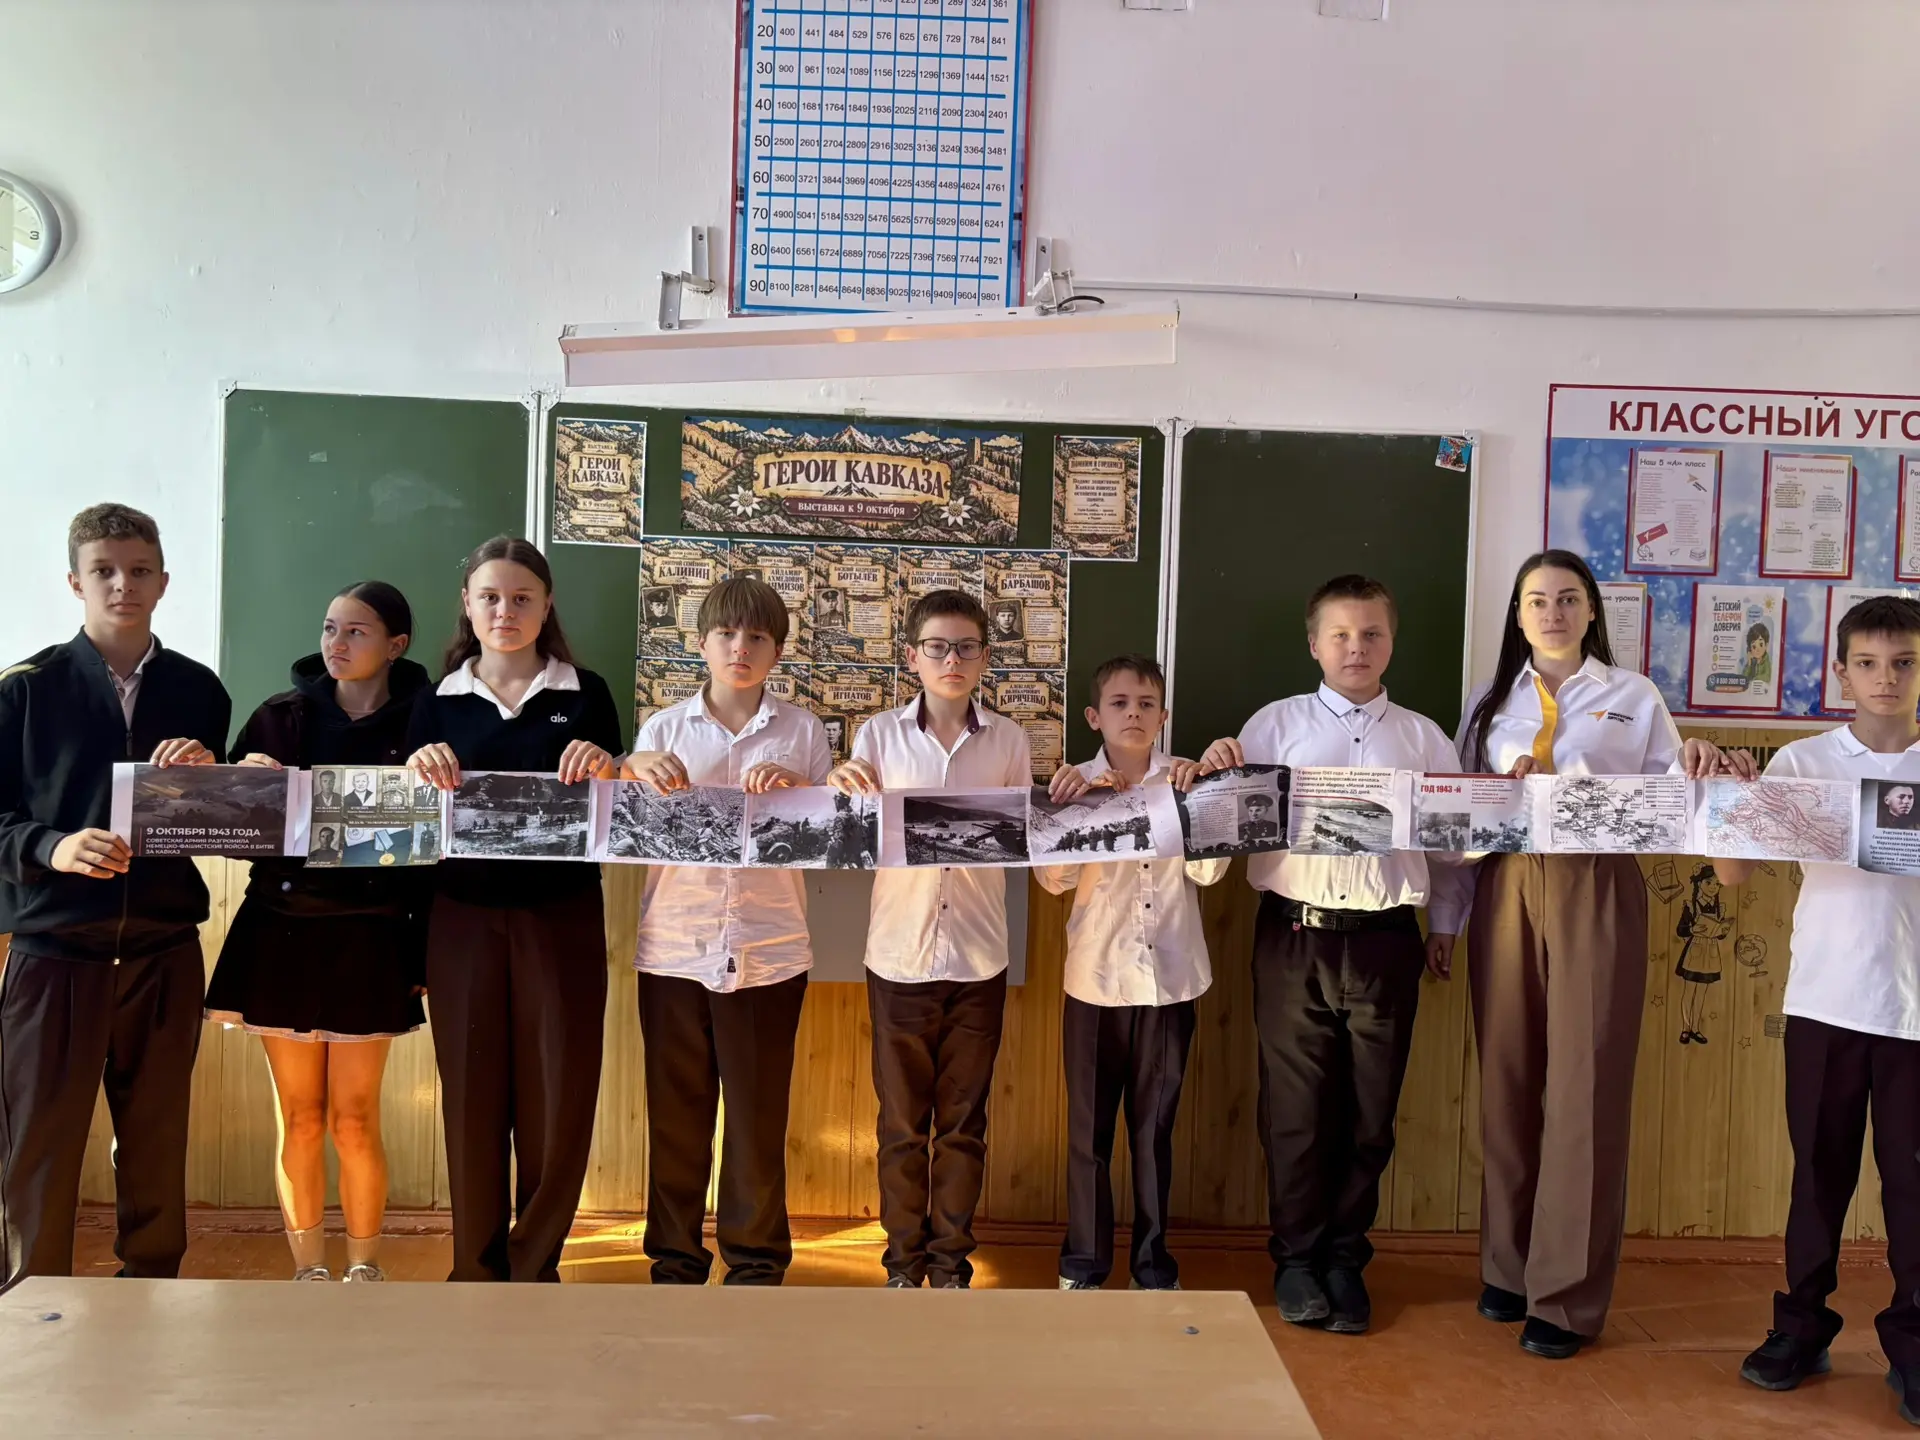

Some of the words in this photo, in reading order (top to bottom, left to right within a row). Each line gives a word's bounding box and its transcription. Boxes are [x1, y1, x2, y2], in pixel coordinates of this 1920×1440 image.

[993, 0, 1008, 8] 361
[757, 25, 774, 38] 20
[780, 27, 795, 36] 400
[805, 29, 820, 38] 441
[829, 29, 844, 39] 484
[852, 30, 868, 39] 529
[876, 31, 891, 40] 576
[900, 32, 915, 41] 625
[923, 33, 939, 42] 676
[946, 34, 961, 43] 729
[970, 35, 985, 44] 784
[991, 36, 1006, 45] 841
[756, 62, 773, 75] 30
[779, 64, 794, 73] 900
[805, 65, 820, 74] 961
[826, 66, 846, 75] 1024
[849, 67, 869, 76] 1089
[874, 68, 893, 77] 1156
[897, 69, 916, 78] 1225
[920, 70, 939, 79] 1296
[942, 71, 961, 80] 1369
[966, 72, 985, 81] 1444
[990, 73, 1009, 82] 1521
[755, 98, 772, 111] 40
[777, 101, 797, 110] 1600
[802, 102, 821, 111] 1681
[825, 103, 845, 112] 1764
[848, 104, 868, 113] 1849
[872, 105, 892, 114] 1936
[895, 106, 915, 115] 2025
[919, 107, 938, 116] 2116
[965, 109, 985, 118] 2304
[988, 110, 1008, 119] 2401
[755, 135, 771, 148] 50
[774, 138, 794, 147] 2500
[800, 139, 820, 148] 2601
[823, 139, 843, 149] 2704
[846, 140, 866, 149] 2809
[870, 141, 890, 150] 2916
[894, 142, 914, 151] 3025
[917, 143, 937, 152] 3136
[940, 144, 960, 153] 3249
[964, 145, 984, 154] 3364
[987, 146, 1007, 155] 3481
[753, 171, 769, 184] 60
[775, 174, 795, 183] 3600
[798, 175, 818, 184] 3721
[822, 176, 842, 185] 3844
[845, 177, 865, 186] 3969
[869, 178, 889, 187] 4096
[892, 179, 912, 188] 4225
[915, 180, 935, 189] 4356
[938, 180, 958, 190] 4489
[961, 181, 980, 190] 4624
[986, 182, 1005, 191] 4761
[752, 207, 768, 220] 70
[773, 210, 794, 219] 4900
[797, 211, 816, 220] 5041
[821, 212, 841, 221] 5184
[844, 213, 864, 222] 5329
[868, 214, 888, 223] 5476
[891, 215, 911, 224] 5625
[914, 216, 934, 225] 5776
[936, 217, 956, 226] 5929
[960, 218, 979, 227] 6084
[985, 219, 1004, 228] 6241
[29, 230, 40, 240] 3
[751, 243, 767, 256] 80
[771, 246, 791, 255] 6400
[796, 247, 816, 256] 6561
[820, 248, 840, 257] 6724
[843, 249, 863, 258] 6889
[867, 250, 887, 259] 7056
[890, 251, 910, 260] 7225
[913, 253, 933, 262] 7396
[937, 254, 956, 263] 7569
[960, 255, 979, 264] 7744
[983, 256, 1003, 265] 7921
[750, 279, 766, 292] 90
[769, 282, 790, 291] 8100
[795, 283, 814, 292] 8281
[819, 284, 839, 293] 8464
[842, 286, 862, 295] 8649
[866, 287, 886, 296] 8836
[889, 288, 909, 297] 9025
[911, 289, 931, 298] 9216
[934, 290, 954, 299] 9409
[957, 291, 977, 300] 9604
[981, 292, 1000, 301] 9801
[1609, 400, 1841, 438] КЛАССНЫЙ
[1855, 408, 1920, 442] УГО
[579, 456, 622, 471] ГЕРОИ
[1640, 458, 1656, 466] Наш
[572, 470, 626, 486] КАВКАЗА
[763, 459, 837, 489] ГЕРОИ
[844, 460, 944, 498] КАВКАЗА
[798, 502, 845, 512] выставка
[848, 504, 854, 512] к
[857, 502, 864, 513] 9
[866, 503, 905, 516] октября
[658, 566, 710, 580] КАЛИНИН
[769, 582, 804, 592] ЧМИЗОВ
[911, 576, 958, 588] ПОКРЫШКИН
[1000, 579, 1050, 590] БАРБАШОВ
[1714, 600, 1740, 612] ДЕТСКИЙ
[1713, 612, 1742, 622] ТЕЛЕФОН
[1714, 622, 1740, 632] ДОВЕРИЯ
[833, 692, 872, 700] ИГНАТОВ
[1000, 694, 1046, 706] КИРИЧЕНКО
[1420, 785, 1434, 793] ГОД
[146, 828, 153, 836] 9
[156, 828, 206, 836] ОКТЯБРЯ
[208, 828, 230, 836] 1943
[233, 828, 260, 837] ГОДА
